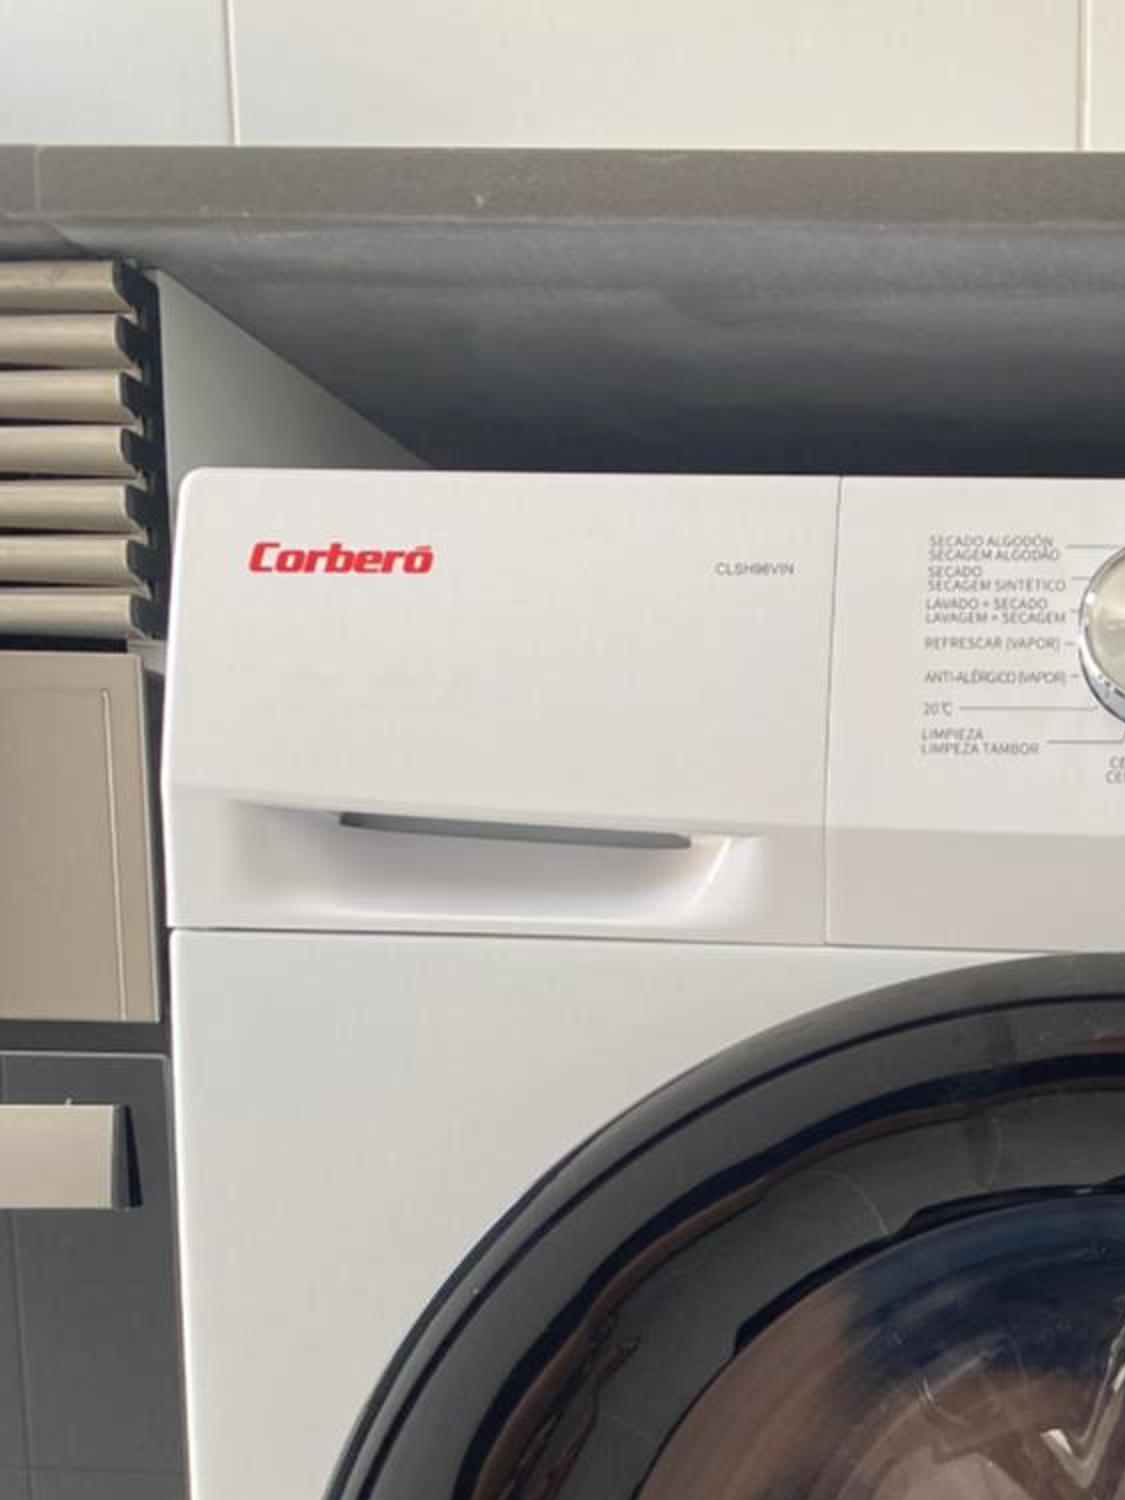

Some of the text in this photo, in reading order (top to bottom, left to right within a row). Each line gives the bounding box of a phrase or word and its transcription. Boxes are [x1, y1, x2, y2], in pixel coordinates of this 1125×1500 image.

[928, 533, 1054, 546] SECADO ALGODÓN
[928, 546, 1060, 560] SECAGEM ALGODÃO
[928, 566, 982, 577] SECADO
[928, 578, 1066, 592] SECAGEM SINTÉTICO
[926, 598, 978, 609] LAVADO
[993, 598, 1048, 609] SECADO
[926, 612, 988, 624] LAVAGEM
[1002, 612, 1066, 624] SECAGEM
[925, 636, 1003, 649] REFRESCAR
[921, 728, 984, 741] LIMPIEZA
[921, 743, 1040, 756] LIMPEZA TAMBOR
